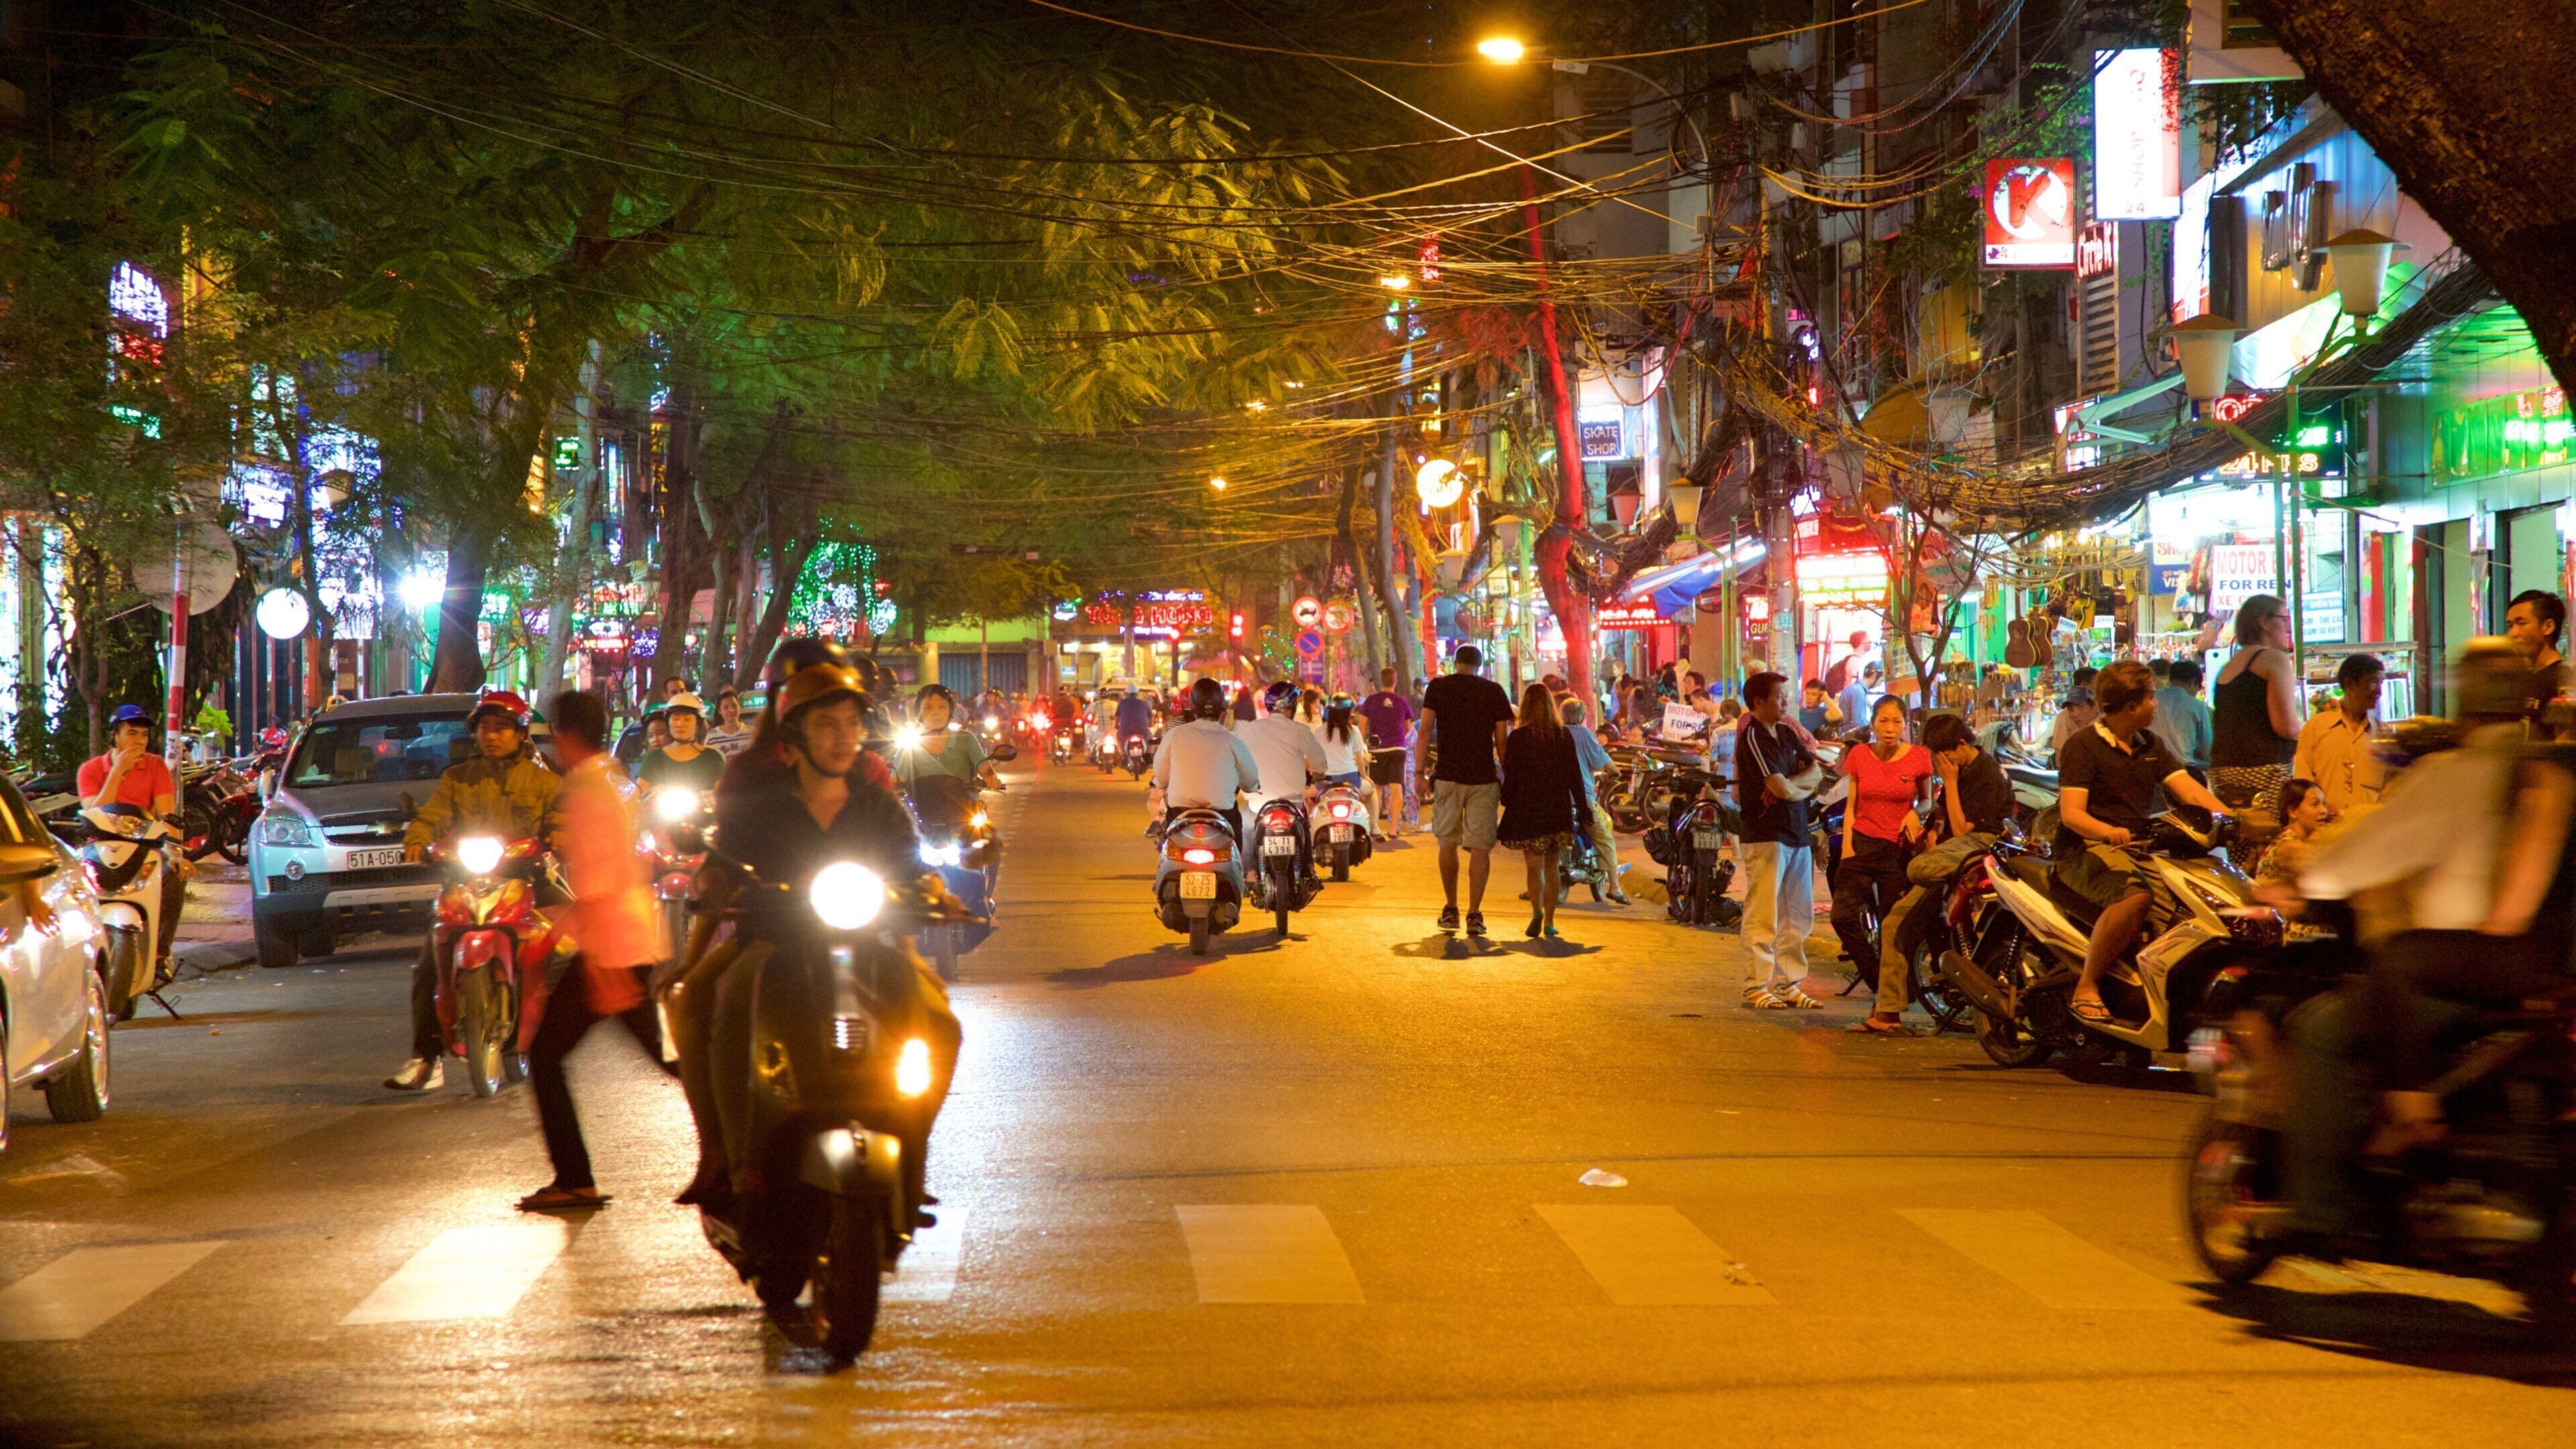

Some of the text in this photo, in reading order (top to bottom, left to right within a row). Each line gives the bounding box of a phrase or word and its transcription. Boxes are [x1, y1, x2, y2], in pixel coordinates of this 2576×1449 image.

[1584, 426, 1618, 439] SKATE
[1587, 443, 1617, 455] SHOP
[2157, 541, 2192, 561] Shop
[2217, 551, 2267, 574] MOTOR
[2220, 579, 2292, 590] FOR REN
[2218, 595, 2233, 606] XE
[1670, 719, 1688, 730] FOR
[1268, 846, 1291, 854] 4396
[1185, 886, 1211, 897] 4672
